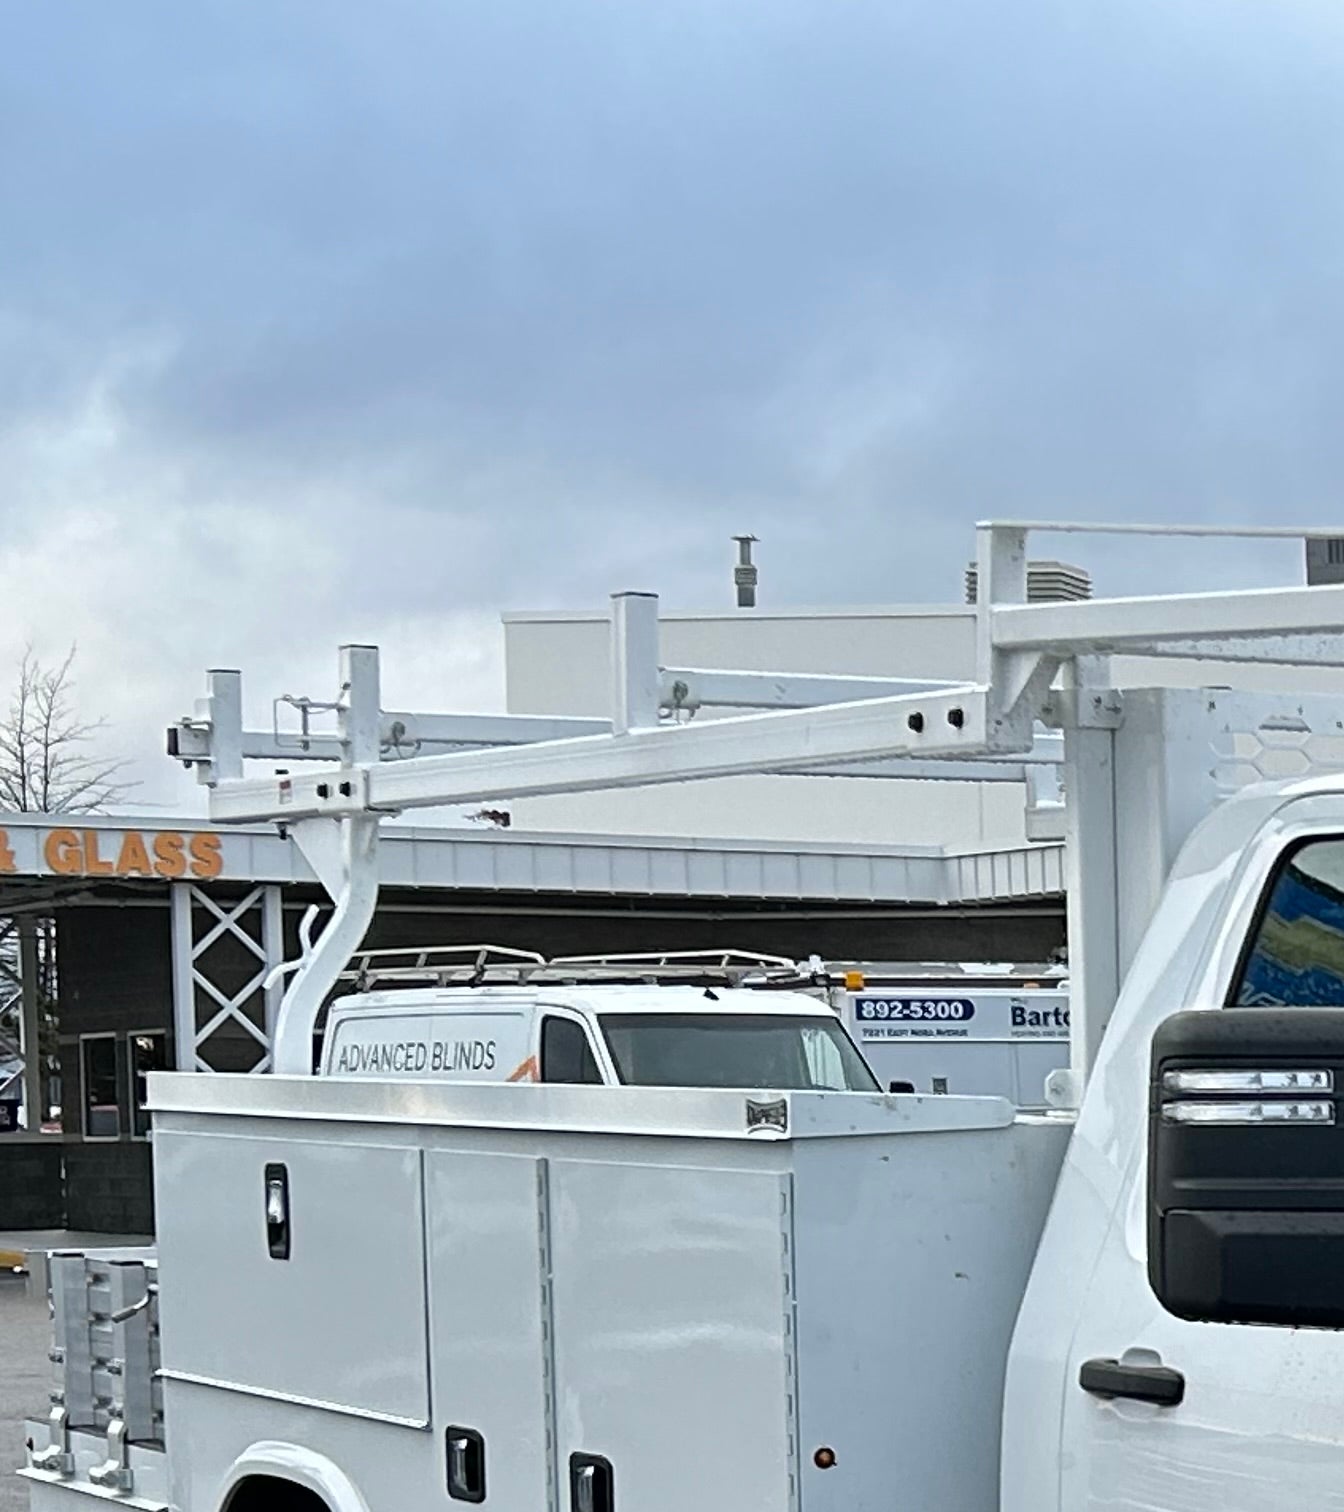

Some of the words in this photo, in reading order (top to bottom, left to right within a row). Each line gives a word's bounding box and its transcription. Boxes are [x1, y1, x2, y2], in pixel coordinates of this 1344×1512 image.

[44, 828, 224, 879] GLASS
[861, 1000, 964, 1020] 892-5300
[338, 1041, 427, 1073] ADVANCED
[430, 1039, 497, 1072] BLINDS
